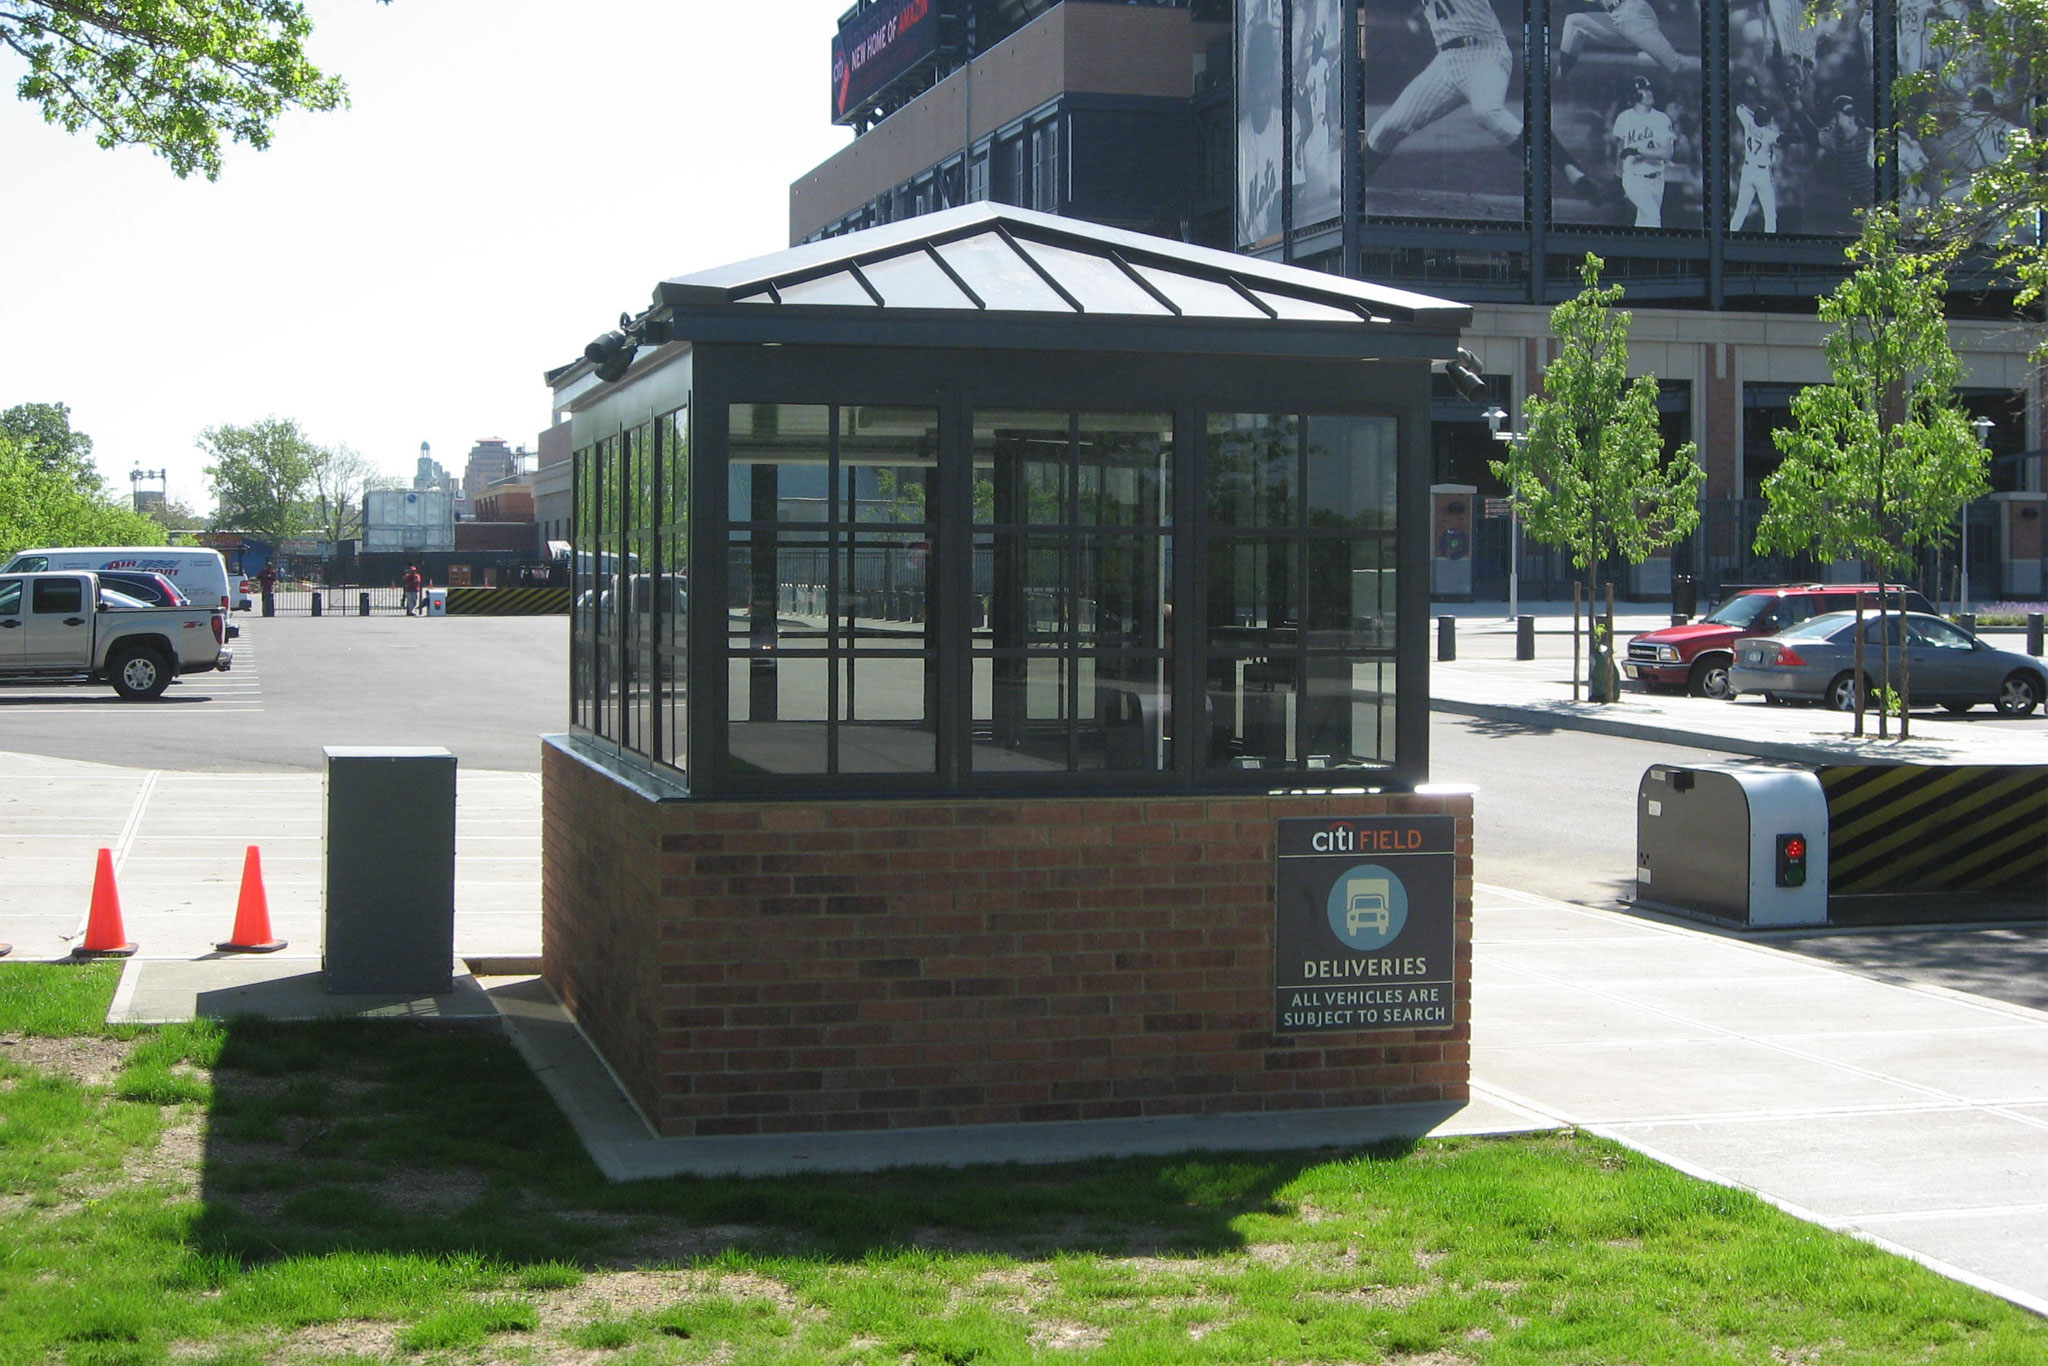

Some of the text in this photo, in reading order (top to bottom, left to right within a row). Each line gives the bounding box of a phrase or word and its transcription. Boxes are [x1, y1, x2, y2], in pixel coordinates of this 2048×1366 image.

[851, 41, 866, 71] NEW
[867, 25, 887, 60] HOME
[887, 15, 898, 43] OF
[1628, 126, 1654, 144] Mets
[1746, 136, 1762, 155] 47
[1312, 826, 1422, 852] citi FIELD
[1304, 957, 1427, 978] DELIVERIES
[1291, 988, 1439, 1007] ALL VEHICLES ARE
[1284, 1007, 1445, 1027] SUBJECT TO SEARCH
